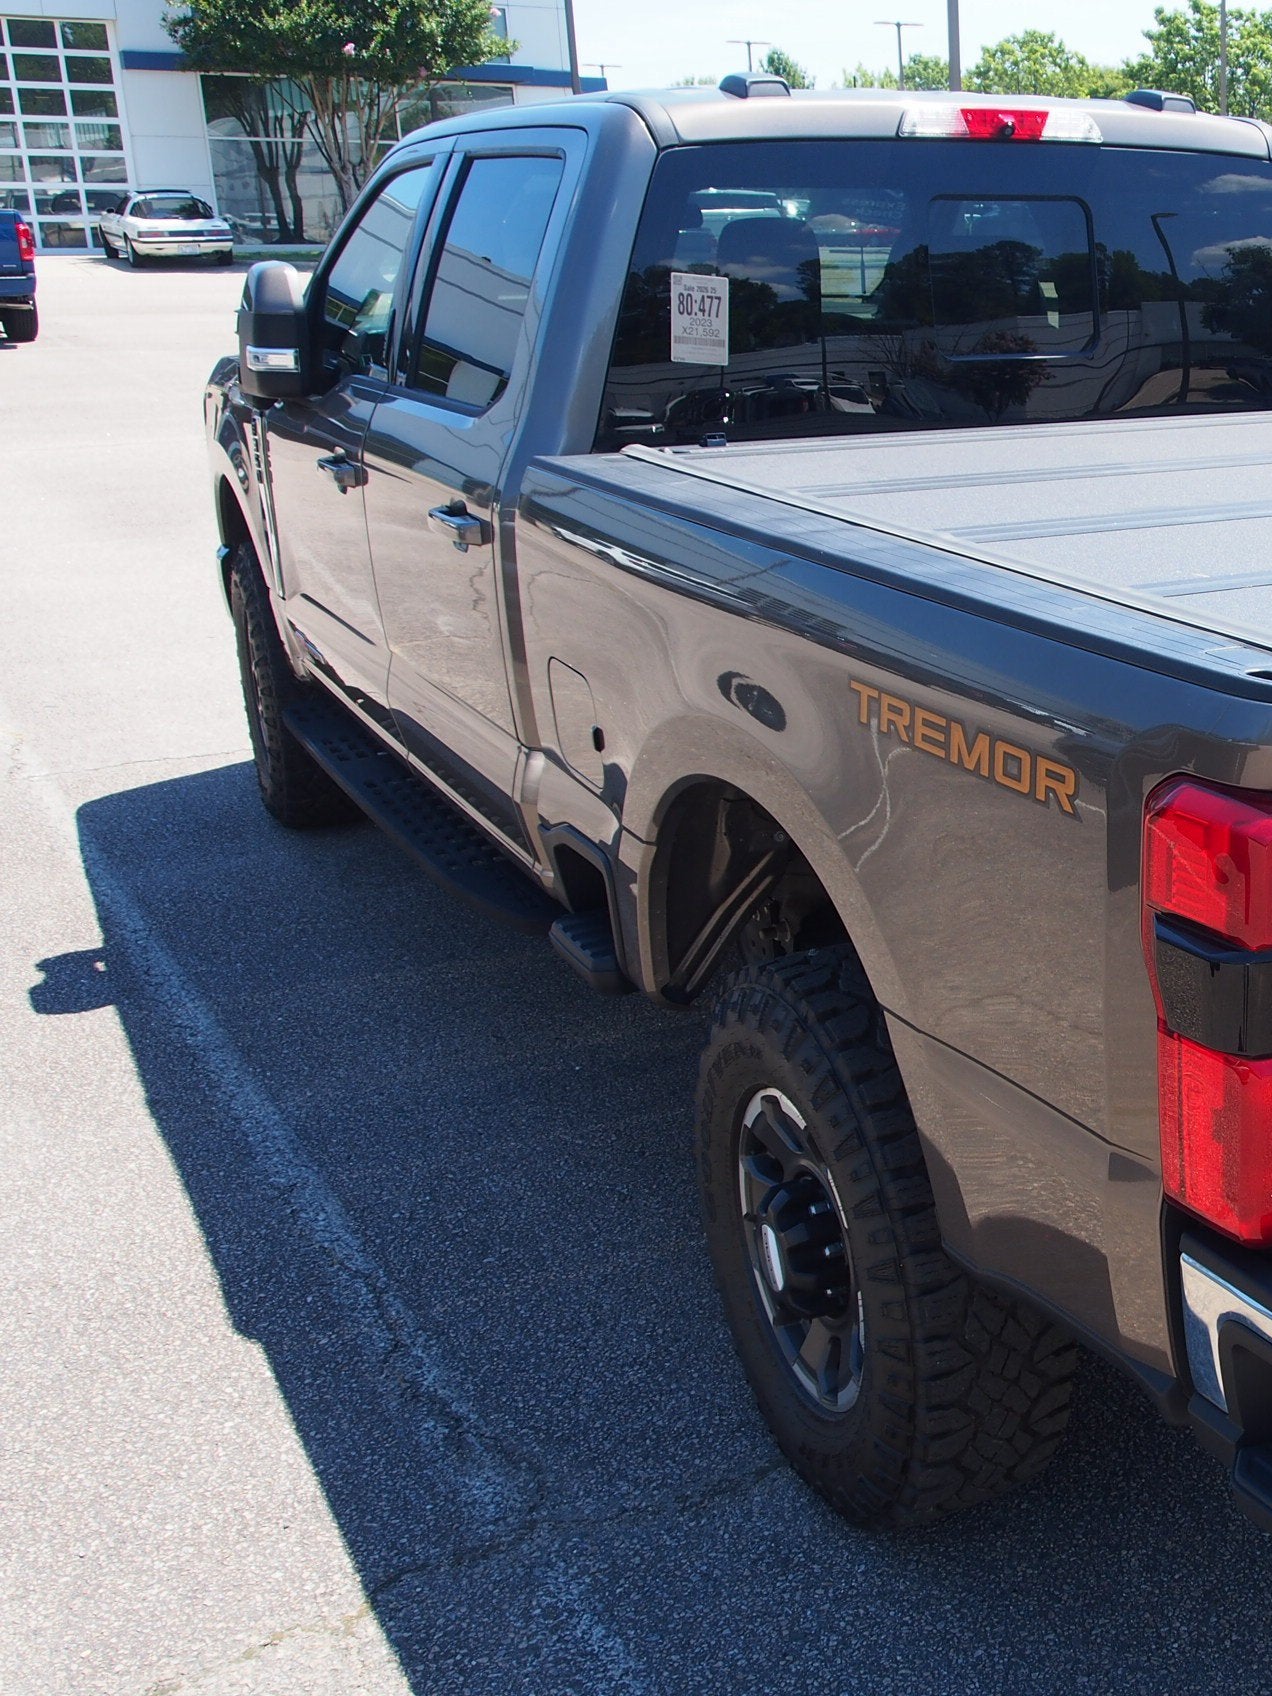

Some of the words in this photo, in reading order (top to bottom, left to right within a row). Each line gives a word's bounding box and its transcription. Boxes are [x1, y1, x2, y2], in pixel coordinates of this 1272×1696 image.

[677, 292, 722, 318] 80:477
[689, 317, 713, 328] 2023
[850, 678, 1076, 816] TREMOR
